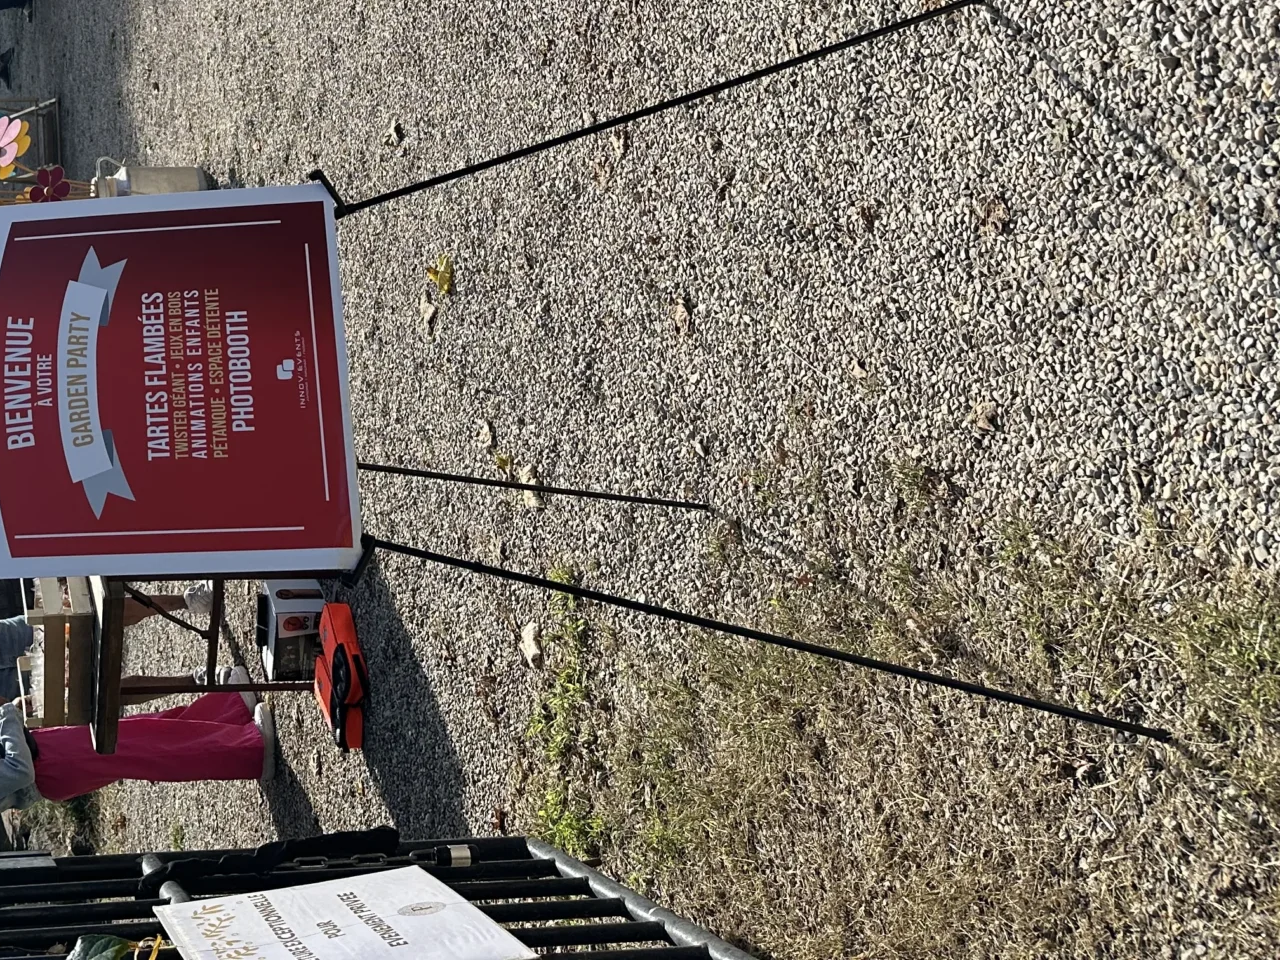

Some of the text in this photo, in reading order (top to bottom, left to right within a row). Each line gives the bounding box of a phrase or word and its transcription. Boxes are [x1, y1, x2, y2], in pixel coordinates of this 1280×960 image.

[4, 316, 35, 450] BIENVENUE
[34, 353, 53, 407] À VOTRE
[66, 311, 95, 448] GARDEN PARTY
[137, 292, 171, 461] TARTES FLAMBÉES
[167, 291, 189, 460] TWISTER GÉANT JEUX EN BOIS
[184, 289, 208, 459] ANIMATIONS ENFANTS
[203, 288, 229, 458] PÉTANQUE ESPACE DÉTENTE
[225, 310, 255, 432] PHOTOBOOTH
[247, 893, 303, 948] EXCEPTIONNELLE
[316, 919, 346, 939] POUR
[357, 912, 409, 947] EVENEMENT
